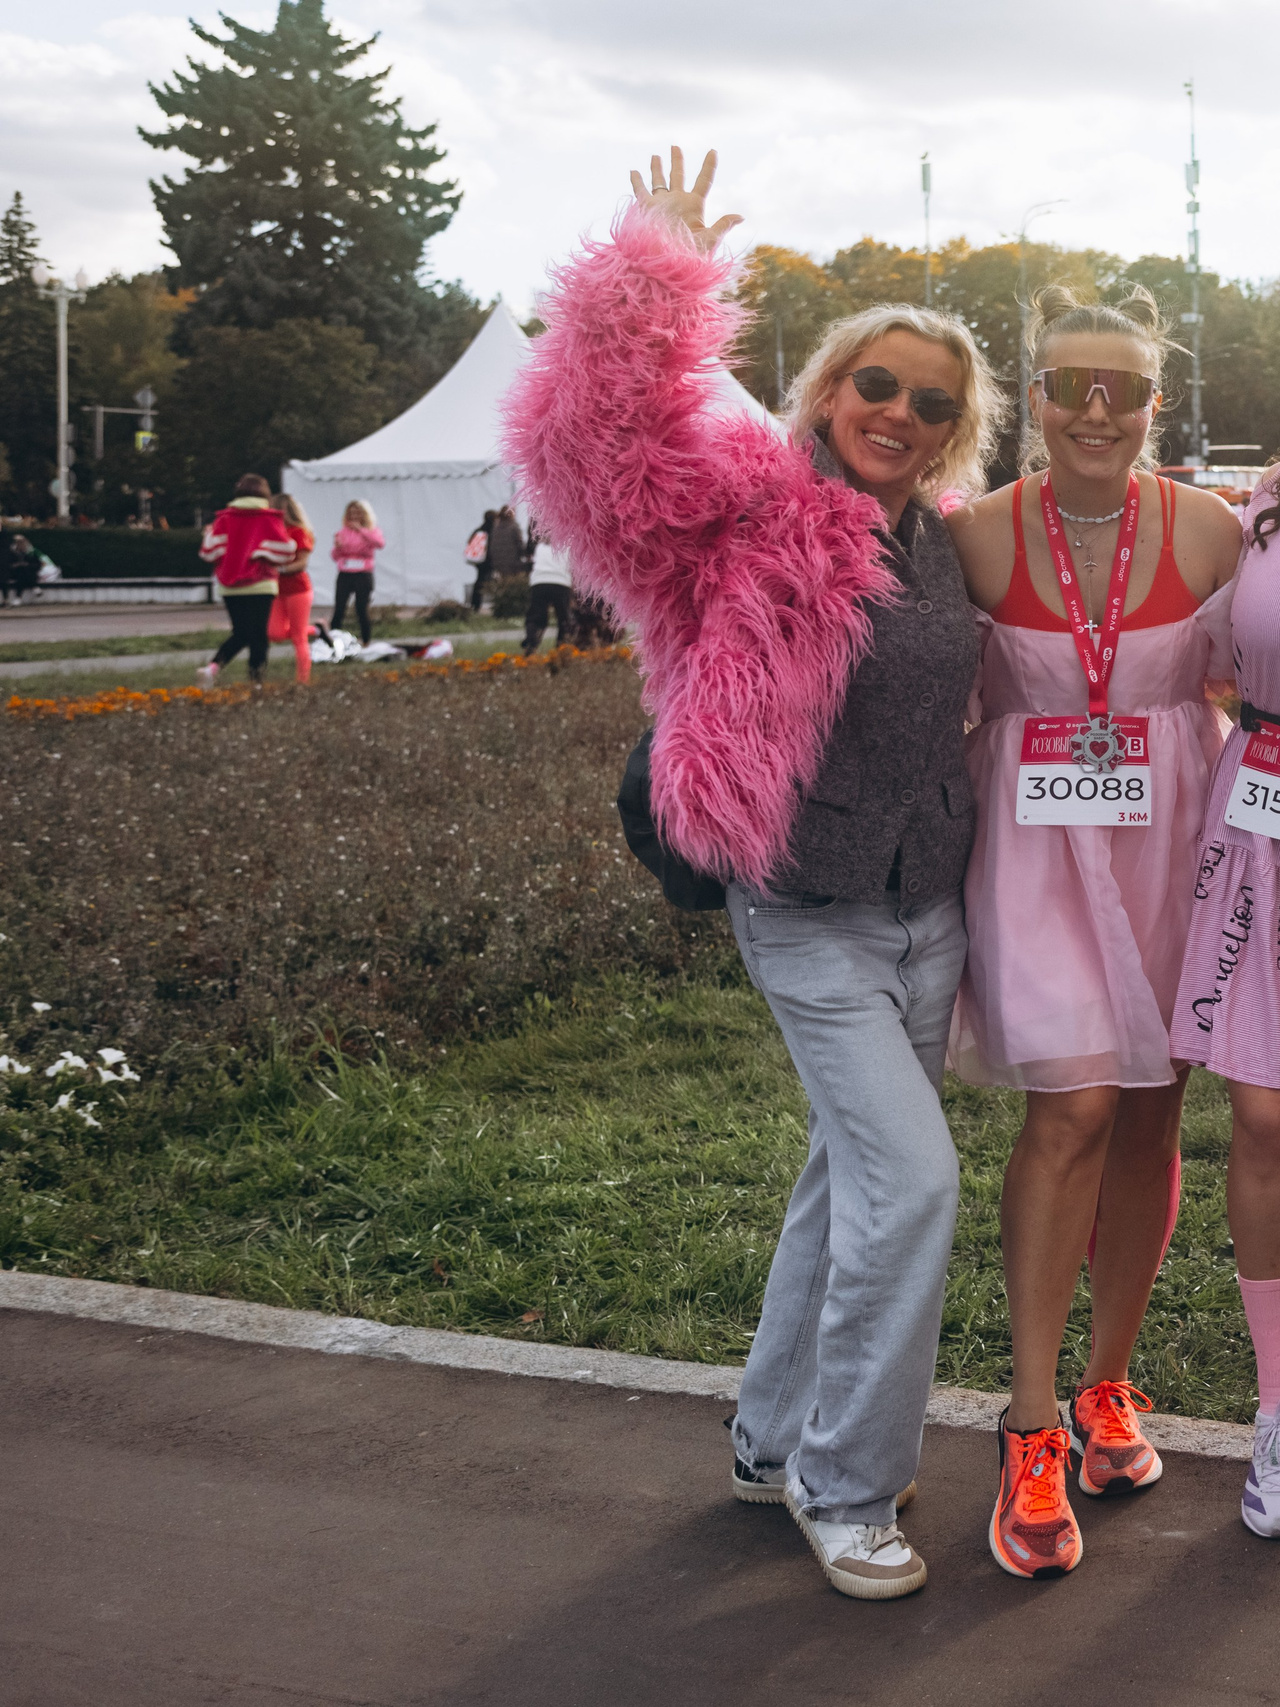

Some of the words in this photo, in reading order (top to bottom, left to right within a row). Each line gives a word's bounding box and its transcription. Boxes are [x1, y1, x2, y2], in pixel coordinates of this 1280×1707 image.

[1249, 740, 1279, 765] РОЗОВЫЙ
[1025, 776, 1144, 801] 30088
[1118, 812, 1126, 822] 3
[1129, 812, 1148, 822] КМ
